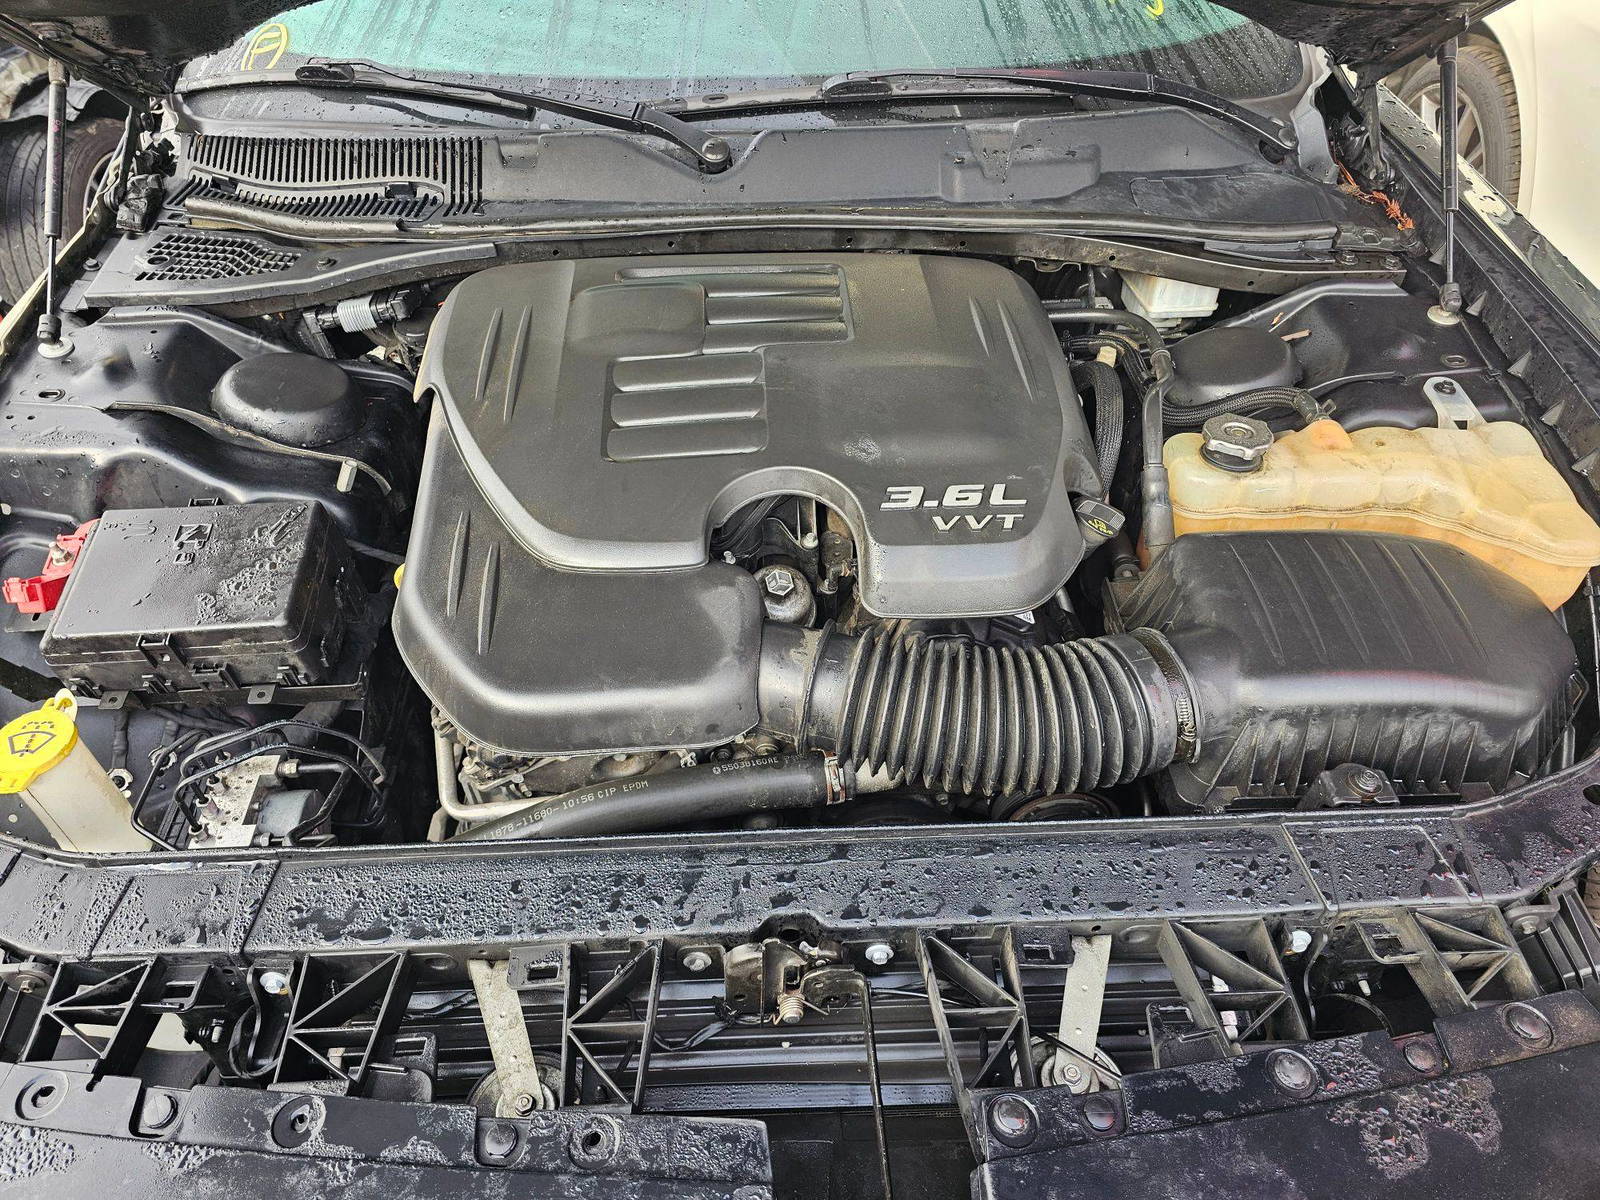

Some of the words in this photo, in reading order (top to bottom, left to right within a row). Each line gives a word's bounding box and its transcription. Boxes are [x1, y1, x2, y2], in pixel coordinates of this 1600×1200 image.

[880, 483, 1027, 512] 3.6L
[932, 514, 1024, 533] VVT
[597, 787, 617, 799] CIP
[622, 780, 649, 793] EPDM
